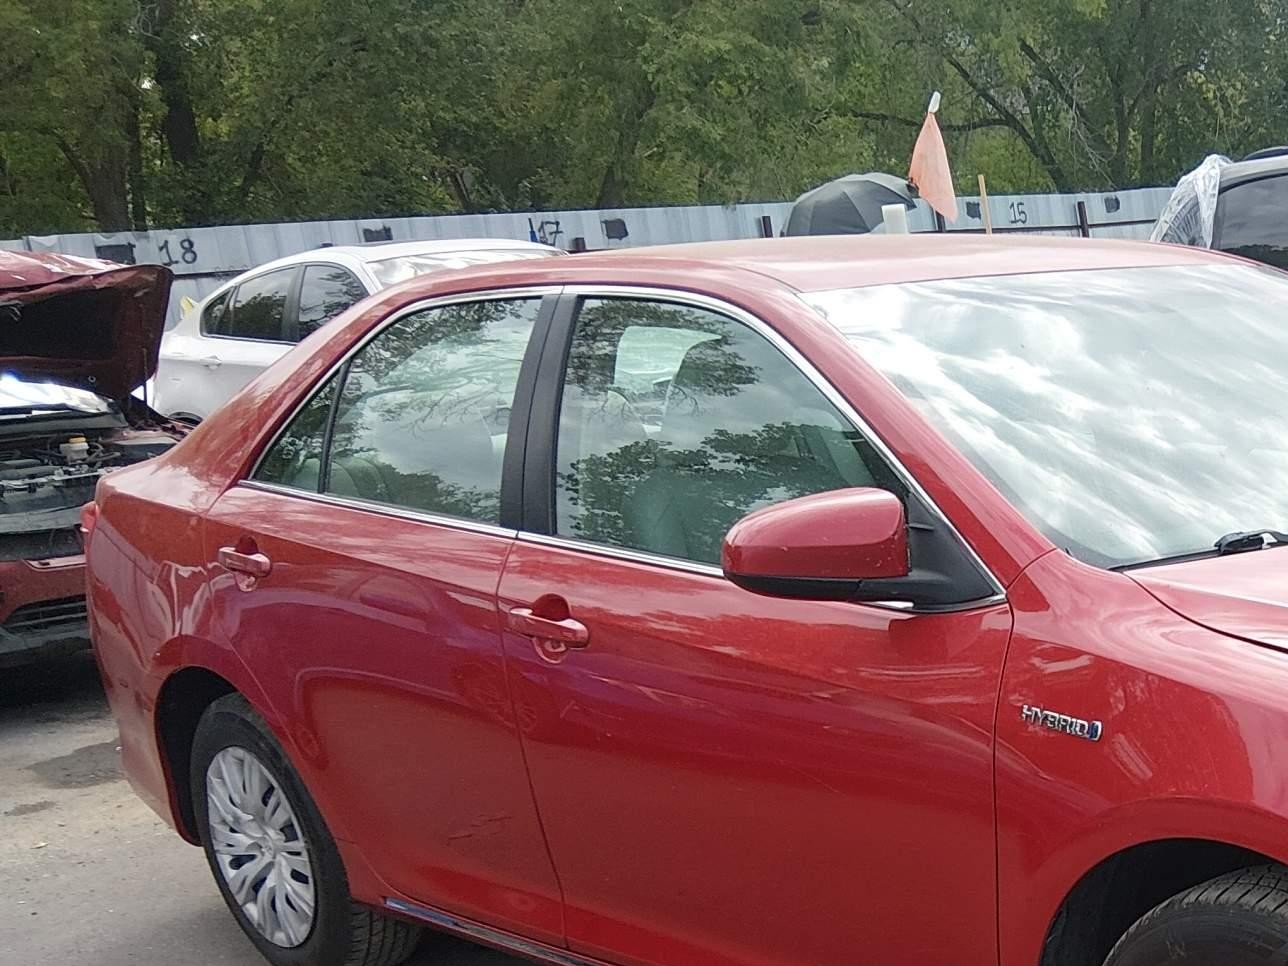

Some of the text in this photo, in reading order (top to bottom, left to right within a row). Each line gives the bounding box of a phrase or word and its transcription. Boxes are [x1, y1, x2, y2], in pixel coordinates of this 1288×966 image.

[1009, 201, 1028, 225] 15
[537, 220, 564, 247] 17
[158, 238, 198, 267] 18
[1021, 704, 1091, 738] HYBRID
